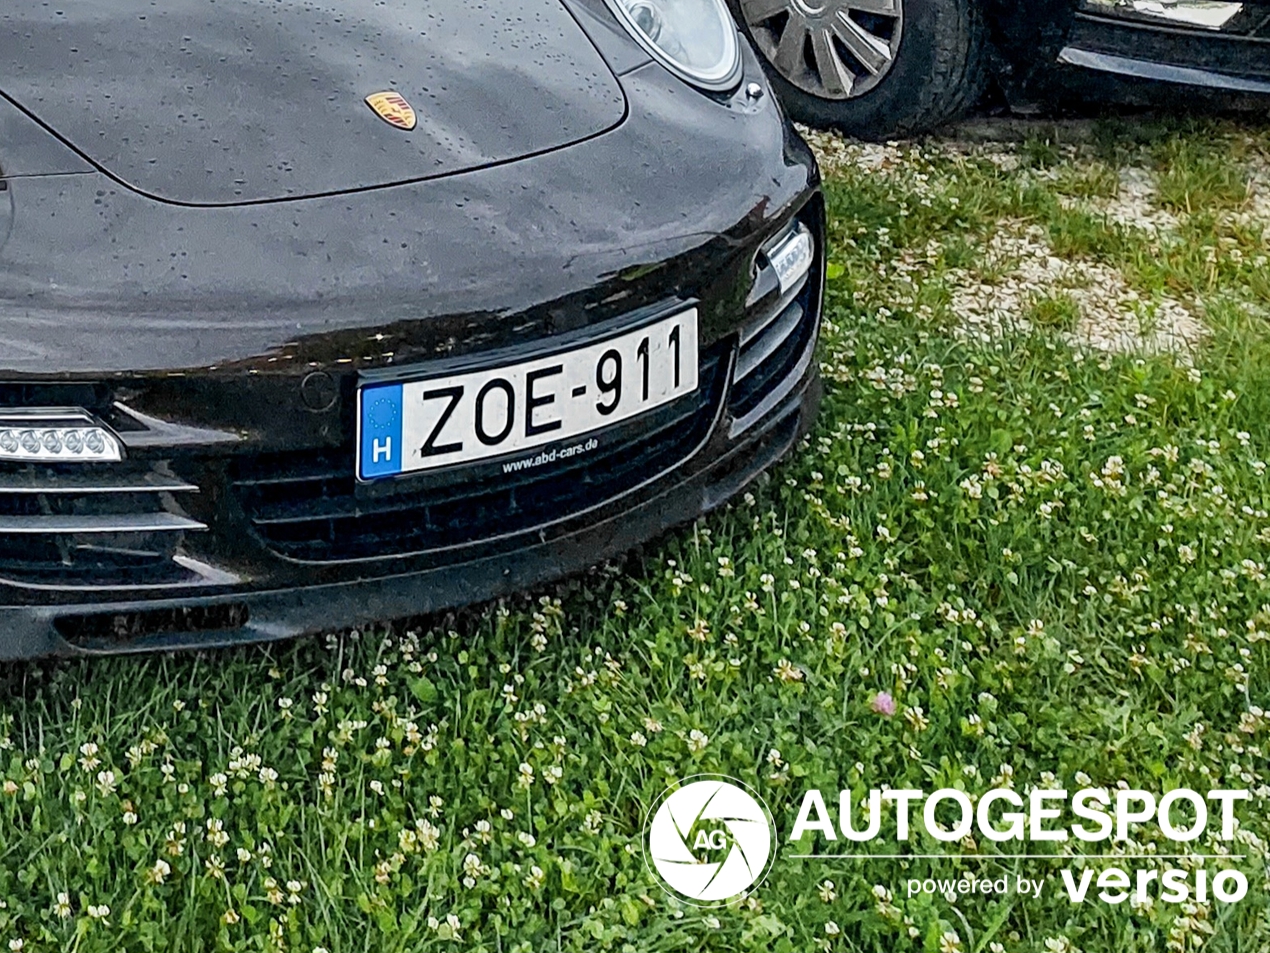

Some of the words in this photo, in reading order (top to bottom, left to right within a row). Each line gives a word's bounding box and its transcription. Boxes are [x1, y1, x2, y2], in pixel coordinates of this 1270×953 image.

[420, 324, 680, 458] ZOE-911
[372, 436, 391, 462] H
[502, 438, 598, 473] www.abd-cars.de
